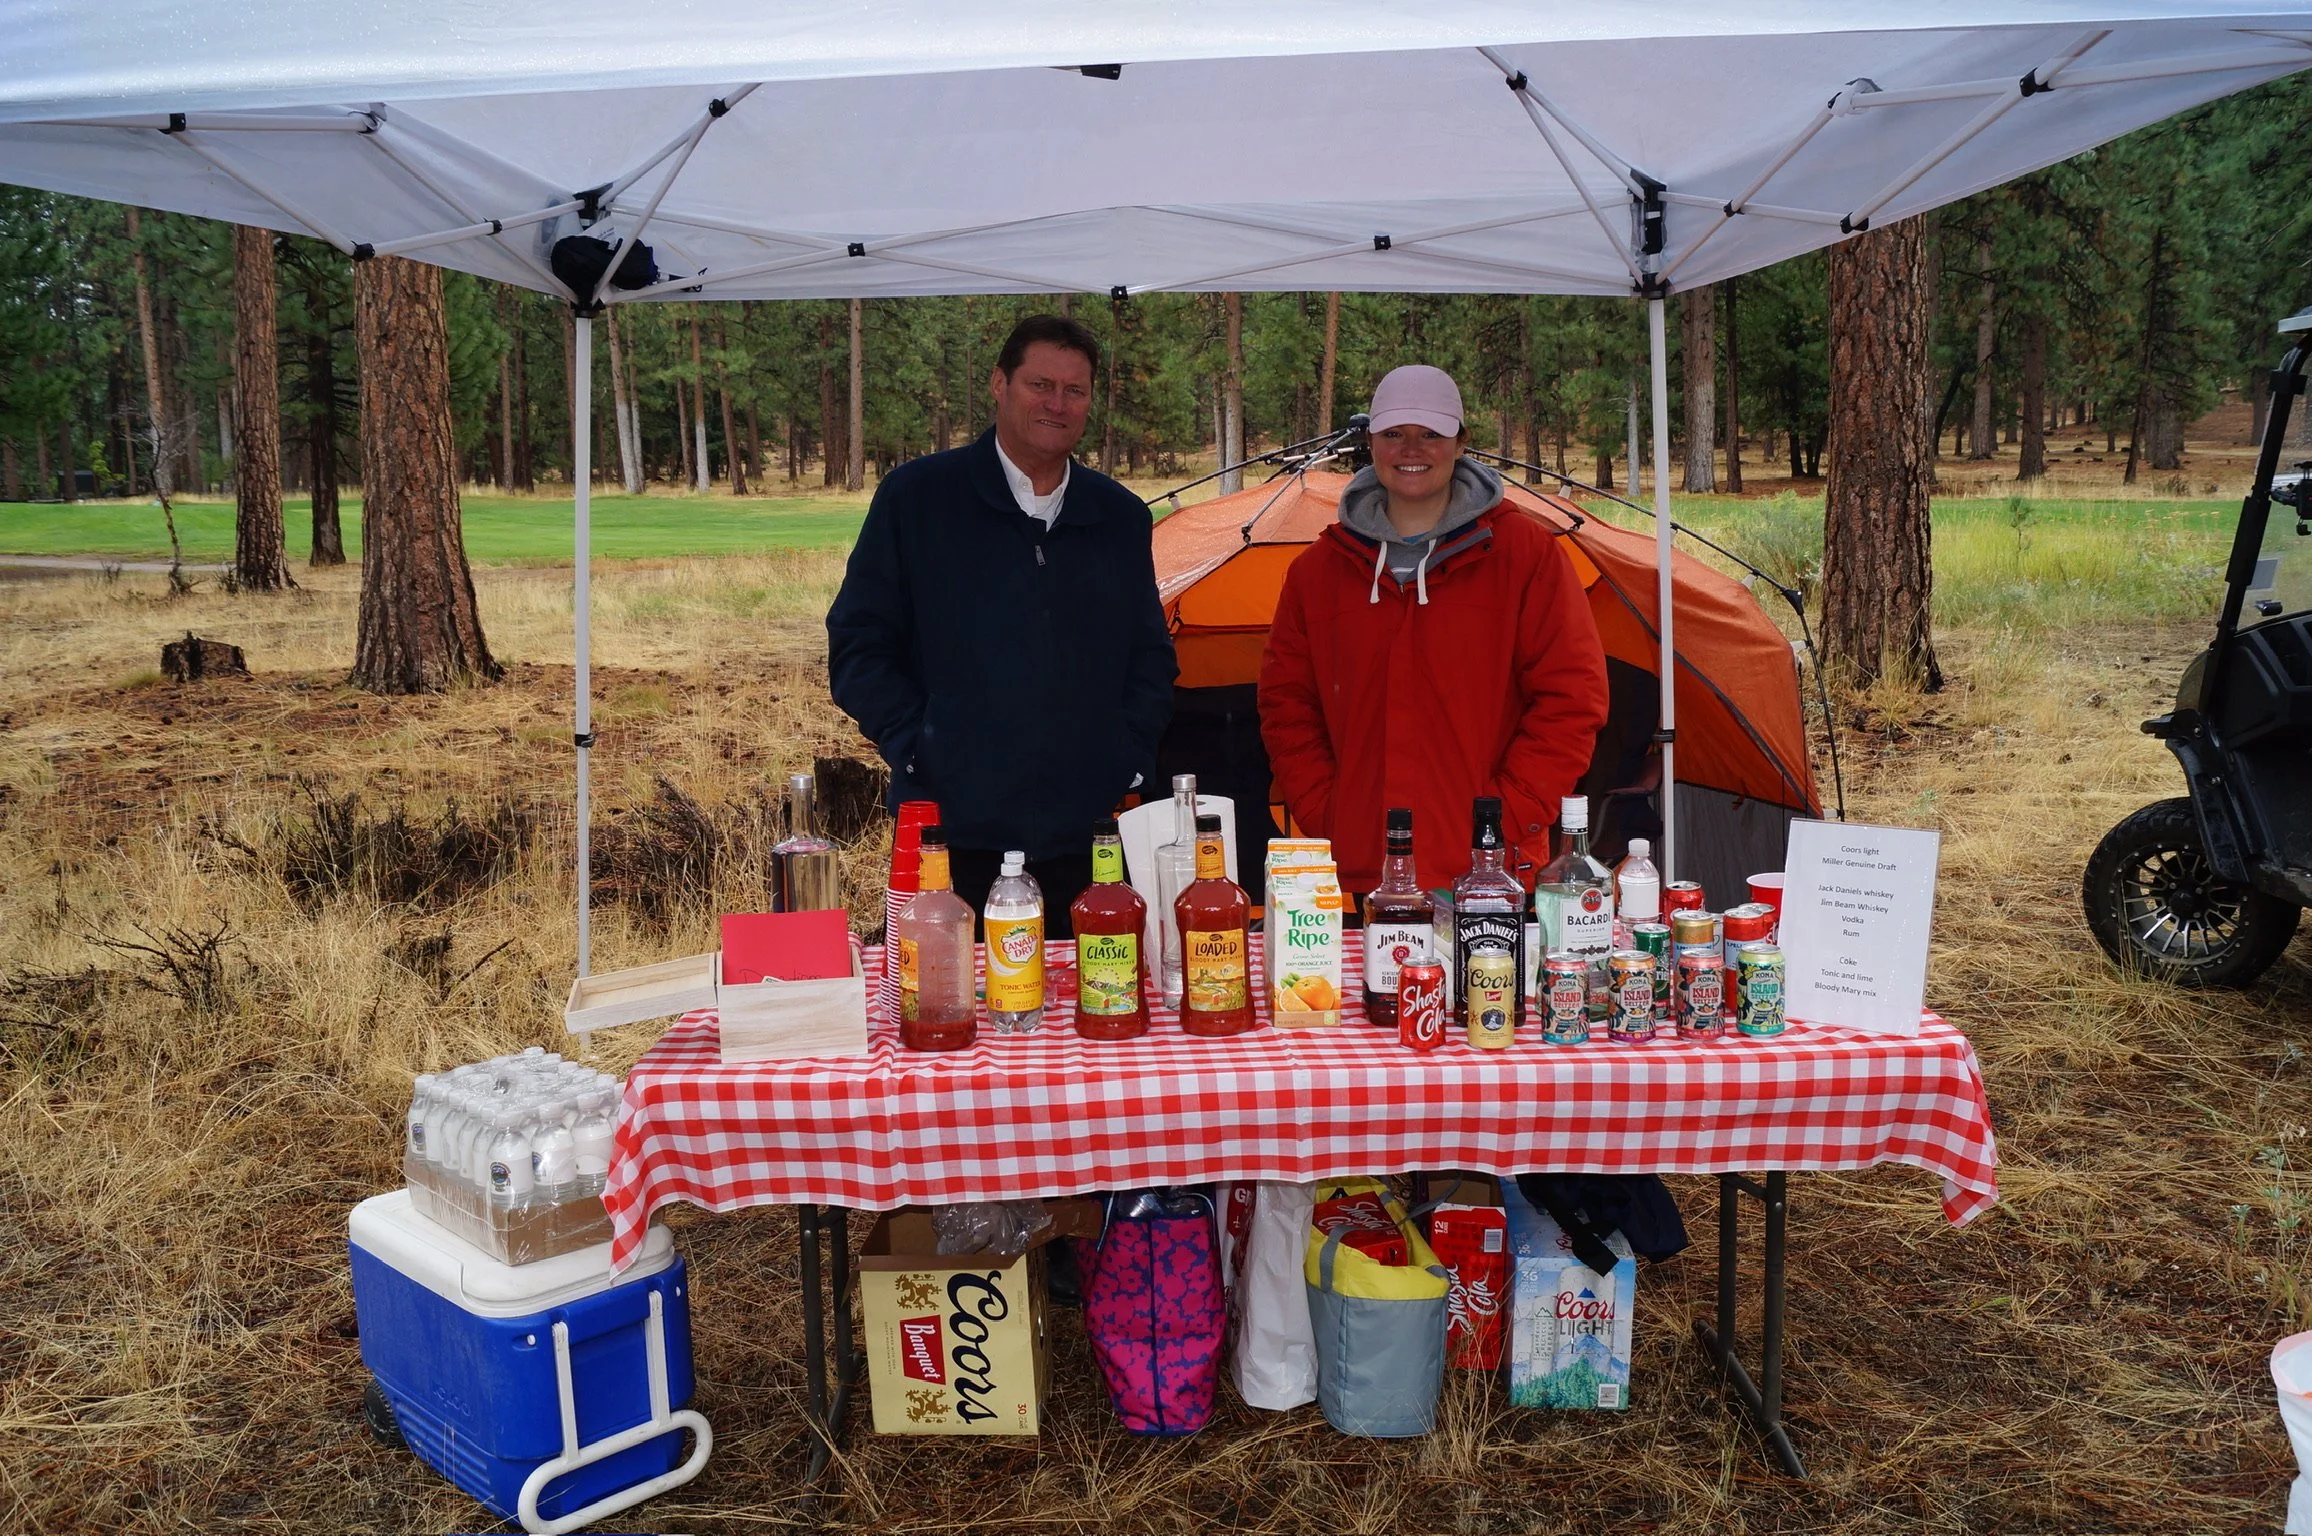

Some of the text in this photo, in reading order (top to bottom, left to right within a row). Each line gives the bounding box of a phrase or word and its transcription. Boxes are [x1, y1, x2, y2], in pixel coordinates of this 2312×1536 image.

[1841, 846, 1879, 856] Coors light
[1822, 857, 1896, 871] Miller Genuine Draft
[1818, 884, 1894, 900] Jack Daniels whiskey
[1820, 898, 1889, 914] Jim Beam Whiskey
[1287, 908, 1326, 927] Tree
[1841, 915, 1864, 924] Vodka
[1460, 921, 1519, 942] JACK DANIEL'S
[1843, 929, 1860, 937] Rum
[1002, 935, 1039, 954] CANADA
[1288, 928, 1330, 951] Ripe
[1377, 930, 1424, 950] JIM BEAM
[1014, 944, 1033, 958] DRY
[1195, 942, 1237, 956] LOADED
[1839, 957, 1858, 966] Coke
[1470, 968, 1514, 989] Coors
[1820, 968, 1874, 983] Tonic and lime
[1000, 983, 1021, 991] TONIC
[1693, 987, 1719, 998] ISLAND
[1751, 983, 1778, 993] ISLAND
[1814, 982, 1840, 993] Bloody
[1841, 986, 1861, 996] Mary
[1554, 992, 1581, 1002] ISLAND
[1624, 990, 1650, 1001] ISLAND
[1416, 1007, 1446, 1041] Cola
[1434, 1220, 1444, 1235] 12
[1466, 1269, 1500, 1316] Cola
[1554, 1291, 1615, 1320] Coors
[1560, 1320, 1613, 1336] LIGHT
[904, 1323, 941, 1379] Banquet
[946, 1270, 1009, 1425] Coors
[1017, 1403, 1027, 1415] 30
